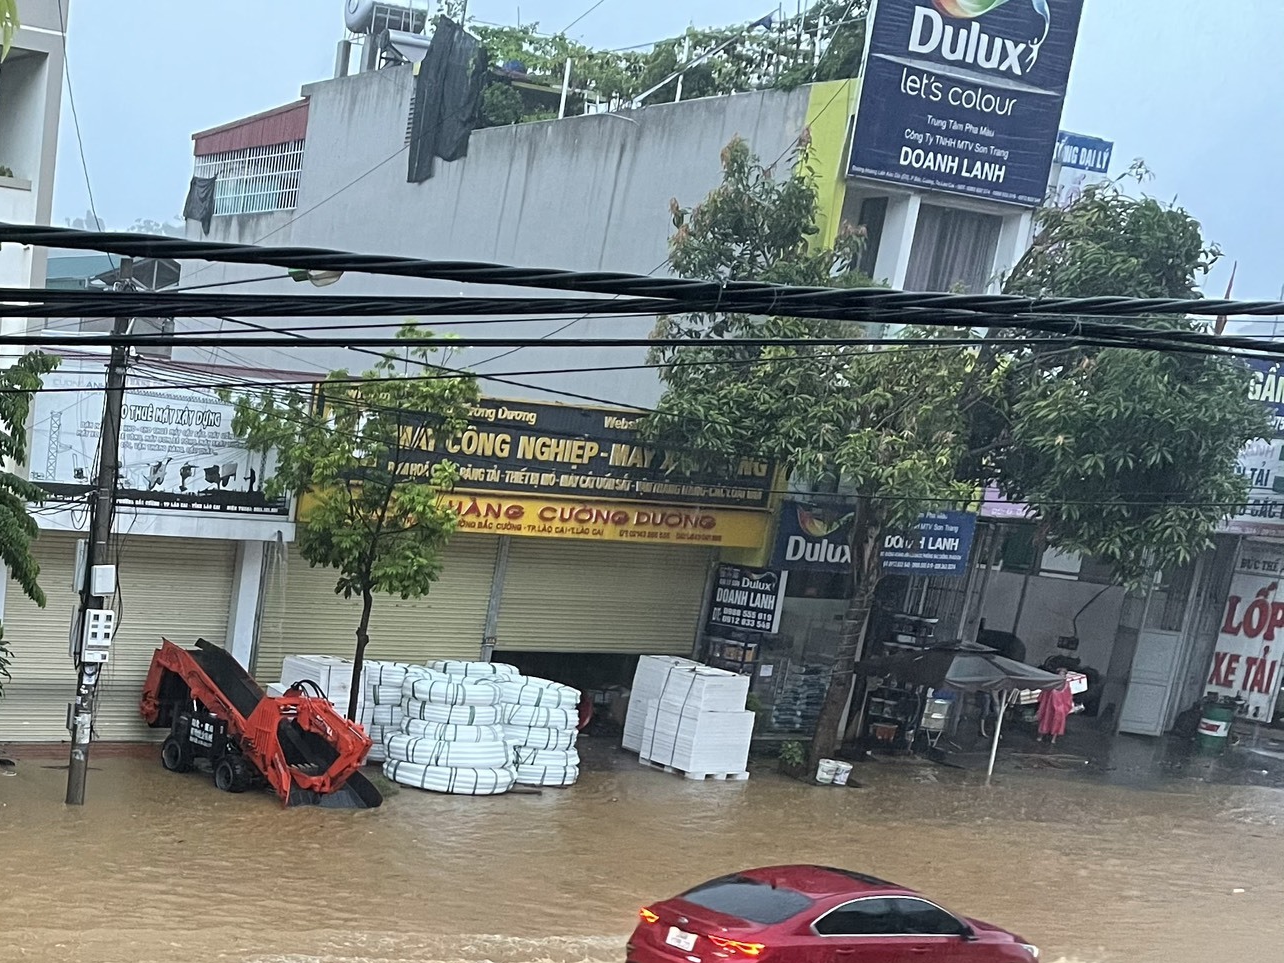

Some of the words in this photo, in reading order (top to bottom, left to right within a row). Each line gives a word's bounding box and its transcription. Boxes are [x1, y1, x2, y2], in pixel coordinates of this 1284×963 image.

[908, 5, 1026, 76] Dulux
[900, 67, 943, 101] let's
[948, 87, 1017, 116] colour
[927, 115, 947, 130] Trung
[948, 119, 964, 132] Tâm
[965, 123, 979, 134] Pha
[904, 128, 924, 144] Công
[925, 133, 934, 146] Ty
[935, 135, 957, 148] TNHH
[956, 139, 974, 151] MTV
[990, 146, 1009, 161] Trang
[1096, 148, 1110, 169] LÝ
[899, 146, 959, 175] DOANH
[961, 158, 1006, 183] LANH
[129, 403, 154, 422] THUÊ
[155, 405, 175, 425] MÁY
[175, 406, 195, 426] XÂY
[445, 425, 511, 459] CÔNG
[517, 434, 600, 469] NGHIỆP
[1250, 461, 1270, 486] TẢI
[785, 535, 851, 563] Dulux
[928, 536, 960, 551] LANH
[741, 577, 771, 591] Dulux
[716, 587, 748, 606] DOANH
[749, 592, 776, 610] LANH
[1221, 581, 1284, 641] LỐP
[1208, 652, 1242, 688] XE
[1242, 645, 1277, 694] TẢI
